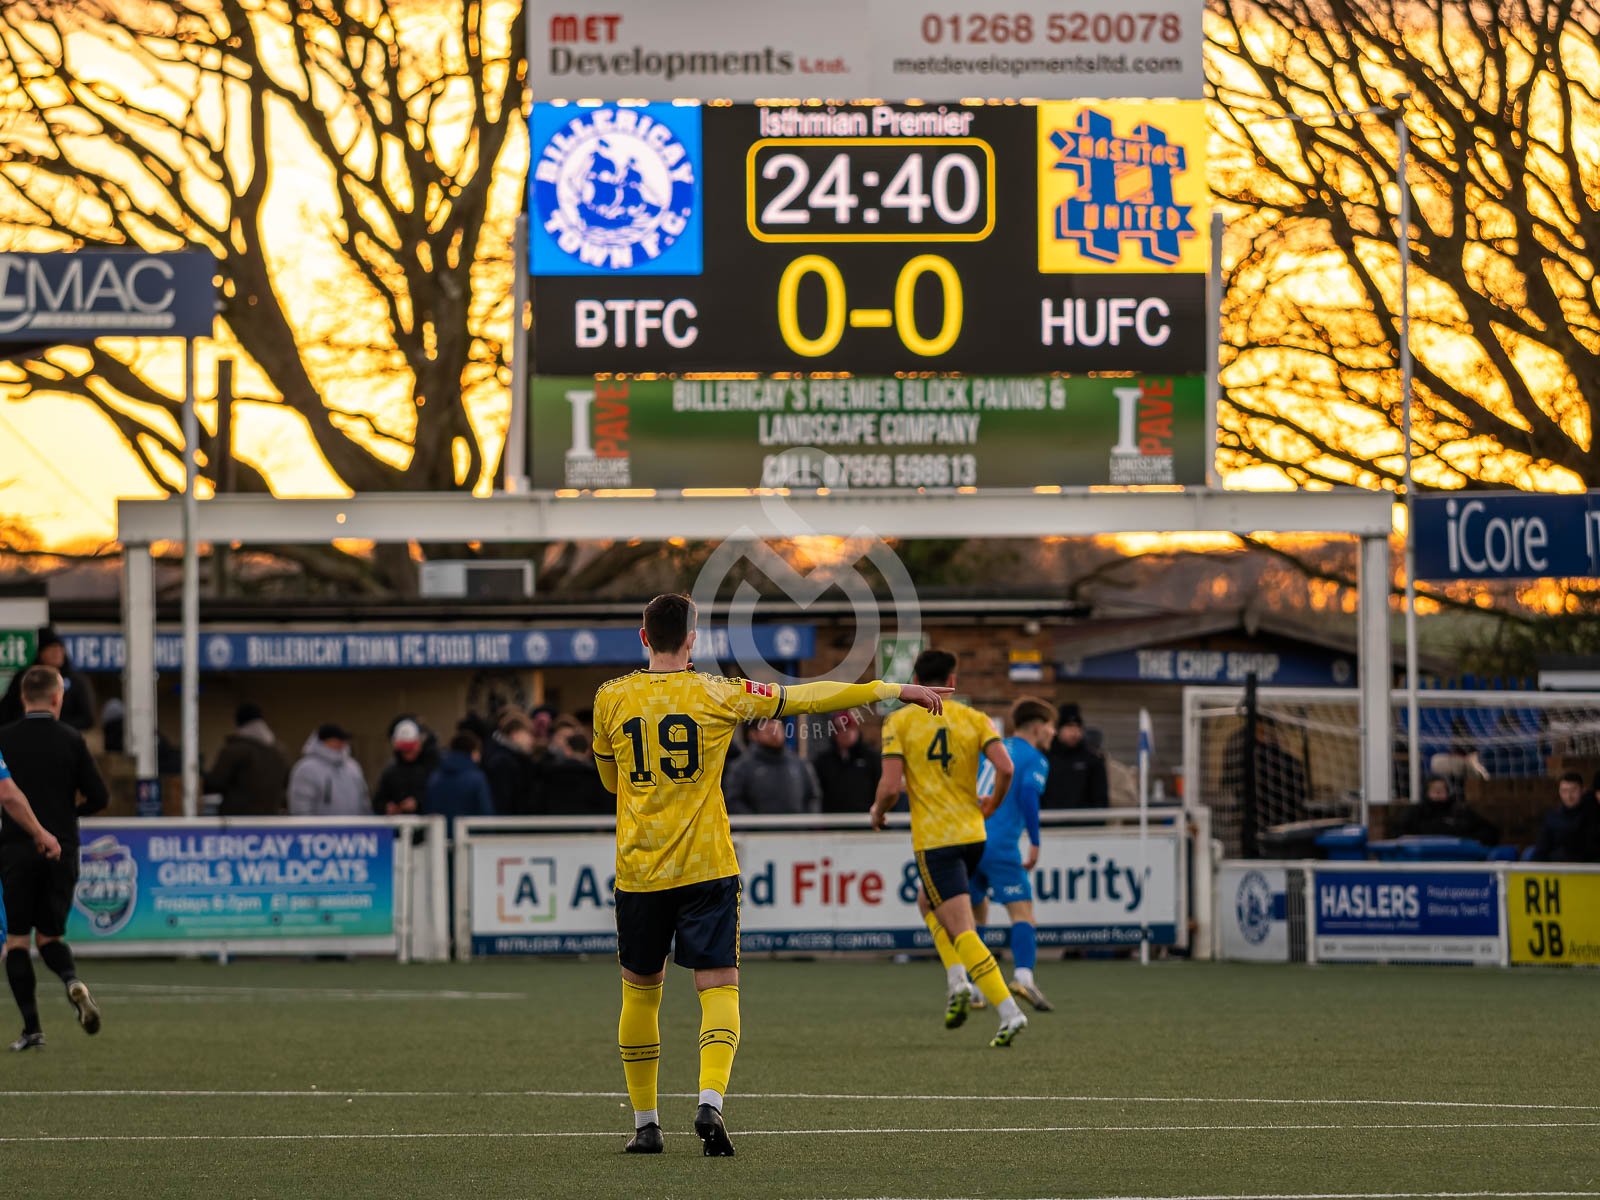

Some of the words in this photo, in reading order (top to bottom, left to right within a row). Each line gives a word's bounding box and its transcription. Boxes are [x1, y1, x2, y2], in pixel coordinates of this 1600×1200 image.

[550, 14, 622, 43] MET
[921, 13, 1033, 43] 01268
[1046, 12, 1182, 43] 520078
[549, 46, 793, 80] Developments
[893, 54, 1183, 77] metdevelopmentsltd.com
[760, 106, 867, 137] Isthmian
[873, 107, 974, 137] Premier
[535, 108, 695, 185] BILLERICAY
[1077, 134, 1179, 167] HASHTAG
[761, 152, 981, 225] 24:40
[1083, 203, 1182, 231] UNITED
[543, 208, 634, 270] TOWN
[575, 298, 698, 348] BTFC
[1041, 297, 1171, 346] HUFC
[673, 379, 806, 412] BILLERICAY'S
[809, 378, 899, 411] PREMIER
[902, 378, 970, 410] BLOCK
[972, 378, 1047, 410] PAVING
[595, 381, 630, 459] PAVE
[759, 413, 879, 445] LANDSCAPE
[880, 413, 981, 444] COMPANY
[1139, 377, 1174, 456] PAVE
[1445, 499, 1549, 573] iCore
[247, 636, 342, 667] BILLERICAY
[346, 635, 399, 666] TOWN
[401, 634, 425, 665] FC
[427, 634, 473, 664] FOOD
[475, 634, 512, 664] HUT
[1137, 651, 1174, 680] THE
[1177, 651, 1224, 681] CHIP
[622, 713, 704, 787] 19
[926, 727, 953, 774] 4
[149, 835, 296, 862] BILLERICAY
[300, 833, 378, 859] TOWN
[158, 860, 232, 887] GIRLS
[239, 858, 369, 885] WILDCATS
[514, 872, 540, 907] A
[791, 858, 883, 906] Fire
[1036, 853, 1151, 913] urity
[1321, 884, 1420, 919] HASLERS
[1525, 878, 1561, 915] RH
[1528, 921, 1564, 957] JB
